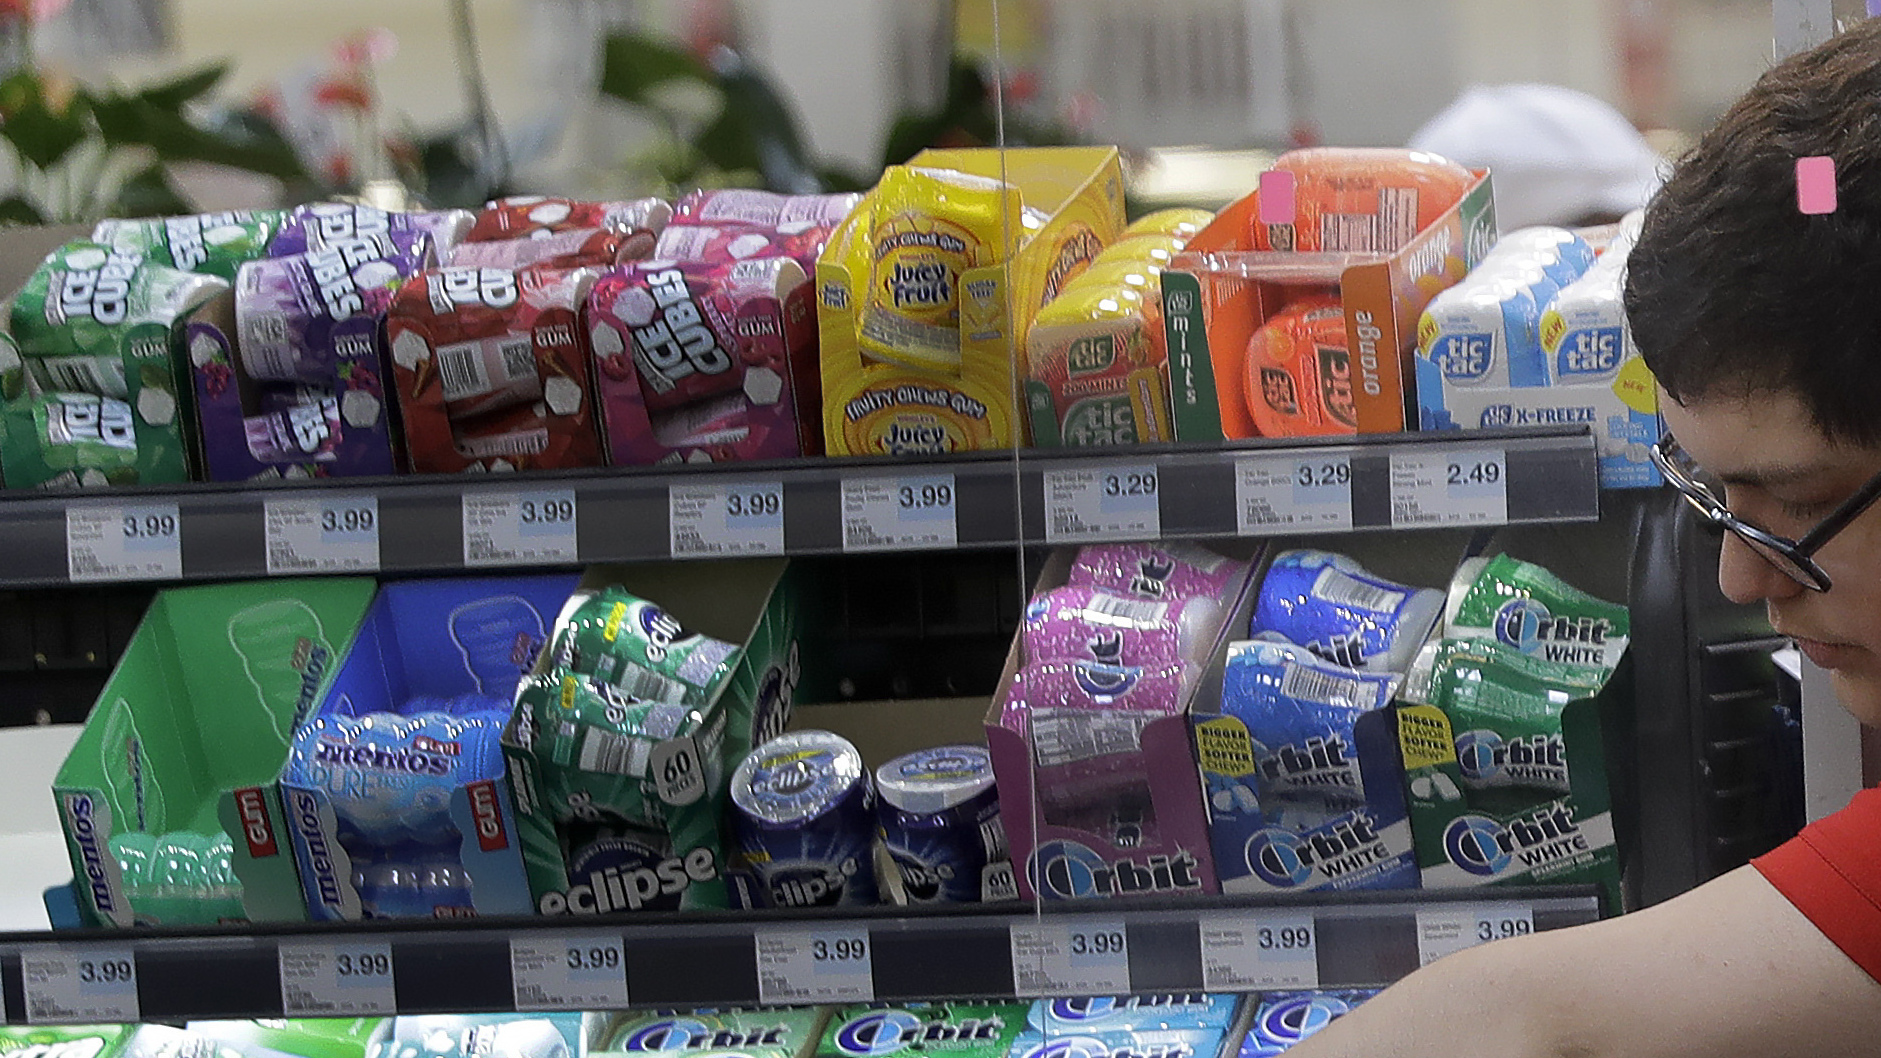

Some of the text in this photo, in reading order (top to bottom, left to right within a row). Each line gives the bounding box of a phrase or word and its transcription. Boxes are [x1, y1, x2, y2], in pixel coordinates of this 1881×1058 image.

[890, 263, 947, 284] Juicy
[647, 269, 733, 376] CUBES
[737, 322, 775, 337] GUM
[632, 319, 688, 381] ICE
[1354, 309, 1384, 396] orange
[1448, 336, 1484, 357] tic
[1576, 330, 1615, 352] tic
[1172, 315, 1197, 405] mints
[1440, 355, 1484, 375] tac
[1567, 350, 1615, 371] tac
[1087, 402, 1132, 426] tic
[1516, 406, 1596, 424] X-FREEZE
[882, 423, 946, 447] Juicy
[1105, 474, 1156, 497] 3.29
[1299, 463, 1350, 487] 3.29
[1447, 463, 1500, 486] 2.49
[727, 494, 780, 517] 3.99
[900, 485, 953, 508] 3.99
[321, 508, 373, 532] 3.99
[521, 501, 573, 524] 3.99
[123, 515, 175, 538] 3.99
[1494, 599, 1609, 654] Orbit
[1544, 644, 1604, 665] WHITE
[1402, 713, 1444, 729] BIGGER
[315, 741, 452, 776] mentos
[663, 749, 691, 779] 60
[1261, 732, 1350, 780] rbit
[1455, 729, 1564, 779] Orbit
[298, 792, 343, 905] mentos
[1444, 803, 1580, 876] Orbit
[1518, 836, 1590, 867] WHITE
[1318, 841, 1391, 880] WHITE
[539, 846, 717, 917] eclipse
[1258, 926, 1311, 950] 3.99
[1478, 919, 1531, 941] 3.99
[813, 937, 866, 961] 3.99
[1071, 932, 1124, 955] 3.99
[337, 954, 389, 977] 3.99
[567, 947, 619, 970] 3.99
[80, 960, 132, 983] 3.99
[834, 1008, 1004, 1056] Orbit
